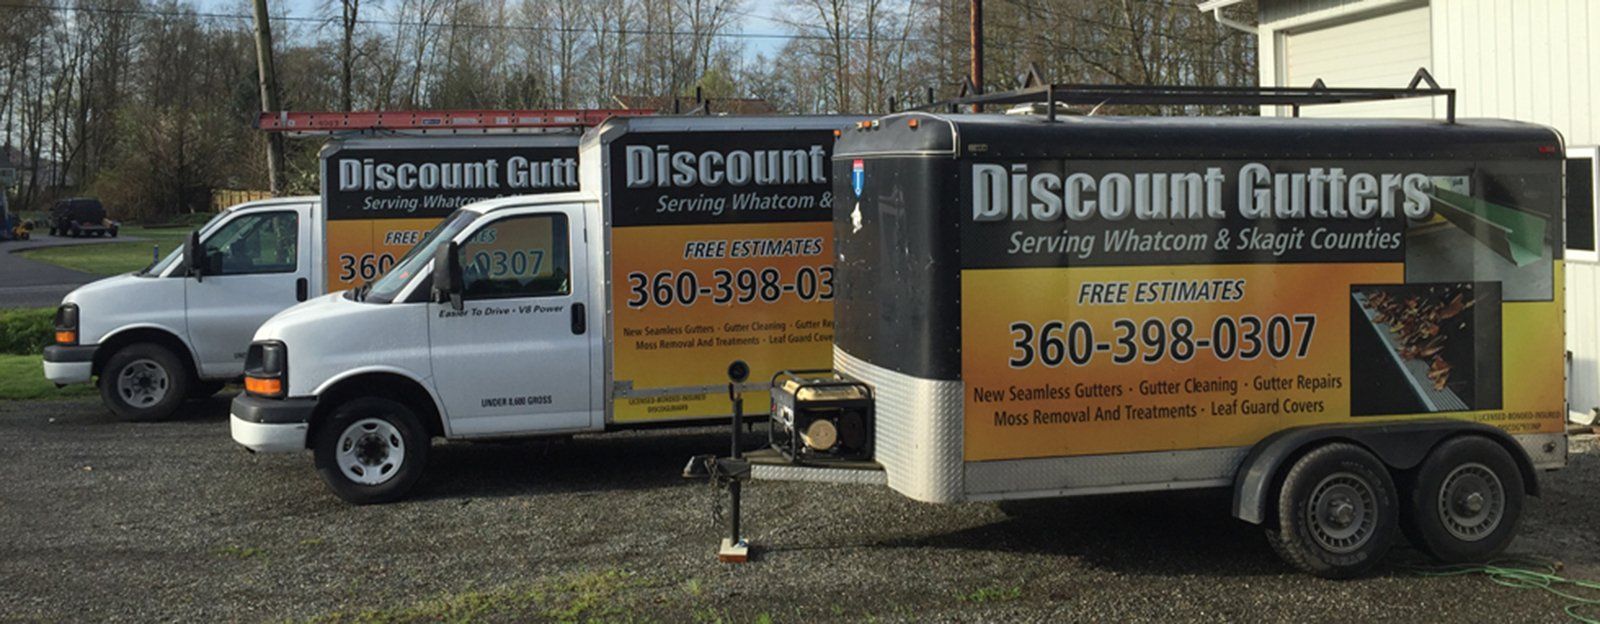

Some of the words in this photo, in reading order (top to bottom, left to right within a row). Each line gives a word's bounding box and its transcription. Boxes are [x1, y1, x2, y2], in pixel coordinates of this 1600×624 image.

[339, 157, 499, 192] Discount
[506, 155, 579, 188] Gutt
[625, 144, 827, 189] Discount
[363, 195, 418, 213] Serving
[656, 193, 727, 215] Serving
[732, 191, 815, 211] Whatcom
[818, 190, 833, 209] &
[972, 163, 1226, 222] Discount
[1238, 162, 1432, 220] Gutters
[384, 230, 418, 246] FREE
[684, 239, 727, 259] FREE
[730, 237, 823, 258] ESTIMATES
[1008, 230, 1096, 259] Serving
[1104, 229, 1208, 252] Whatcom
[1213, 228, 1231, 250] &
[1236, 226, 1305, 256] Skagit
[1310, 227, 1401, 250] Counties
[626, 265, 834, 308] 360-398-03
[1078, 281, 1130, 305] FREE
[1134, 278, 1246, 304] ESTIMATES
[439, 308, 468, 318] Easier
[471, 307, 483, 317] To
[485, 306, 510, 316] Drive
[518, 305, 532, 314] V8
[533, 304, 564, 314] Power
[623, 327, 643, 337] New
[645, 325, 683, 336] Seamless
[684, 324, 714, 335] Gutters
[723, 323, 749, 333] Gutter
[751, 321, 786, 333] Cleaning
[794, 319, 821, 330] Gutter
[635, 340, 657, 350] Moss
[659, 338, 695, 349] Removal
[696, 337, 714, 348] And
[715, 336, 760, 347] Treatments
[769, 334, 786, 345] Leaf
[787, 333, 813, 344] Guard
[813, 333, 833, 343] Cove
[1009, 313, 1316, 369] 360-398-0307
[481, 397, 507, 408] UNDER
[527, 394, 553, 405] GROSS
[974, 387, 1005, 403] New
[1009, 384, 1070, 402] Seamless
[1075, 382, 1123, 399] Gutters
[1139, 379, 1180, 396] Gutter
[1184, 376, 1238, 396] Cleaning
[1253, 375, 1293, 392] Gutter
[1297, 373, 1342, 393] Repairs
[994, 411, 1029, 427] Moss
[1033, 407, 1090, 425] Removal
[1094, 405, 1121, 422] And
[1125, 403, 1197, 420] Treatments
[1211, 399, 1238, 416] Leaf
[1241, 398, 1279, 415] Guard
[1283, 397, 1325, 414] Covers
